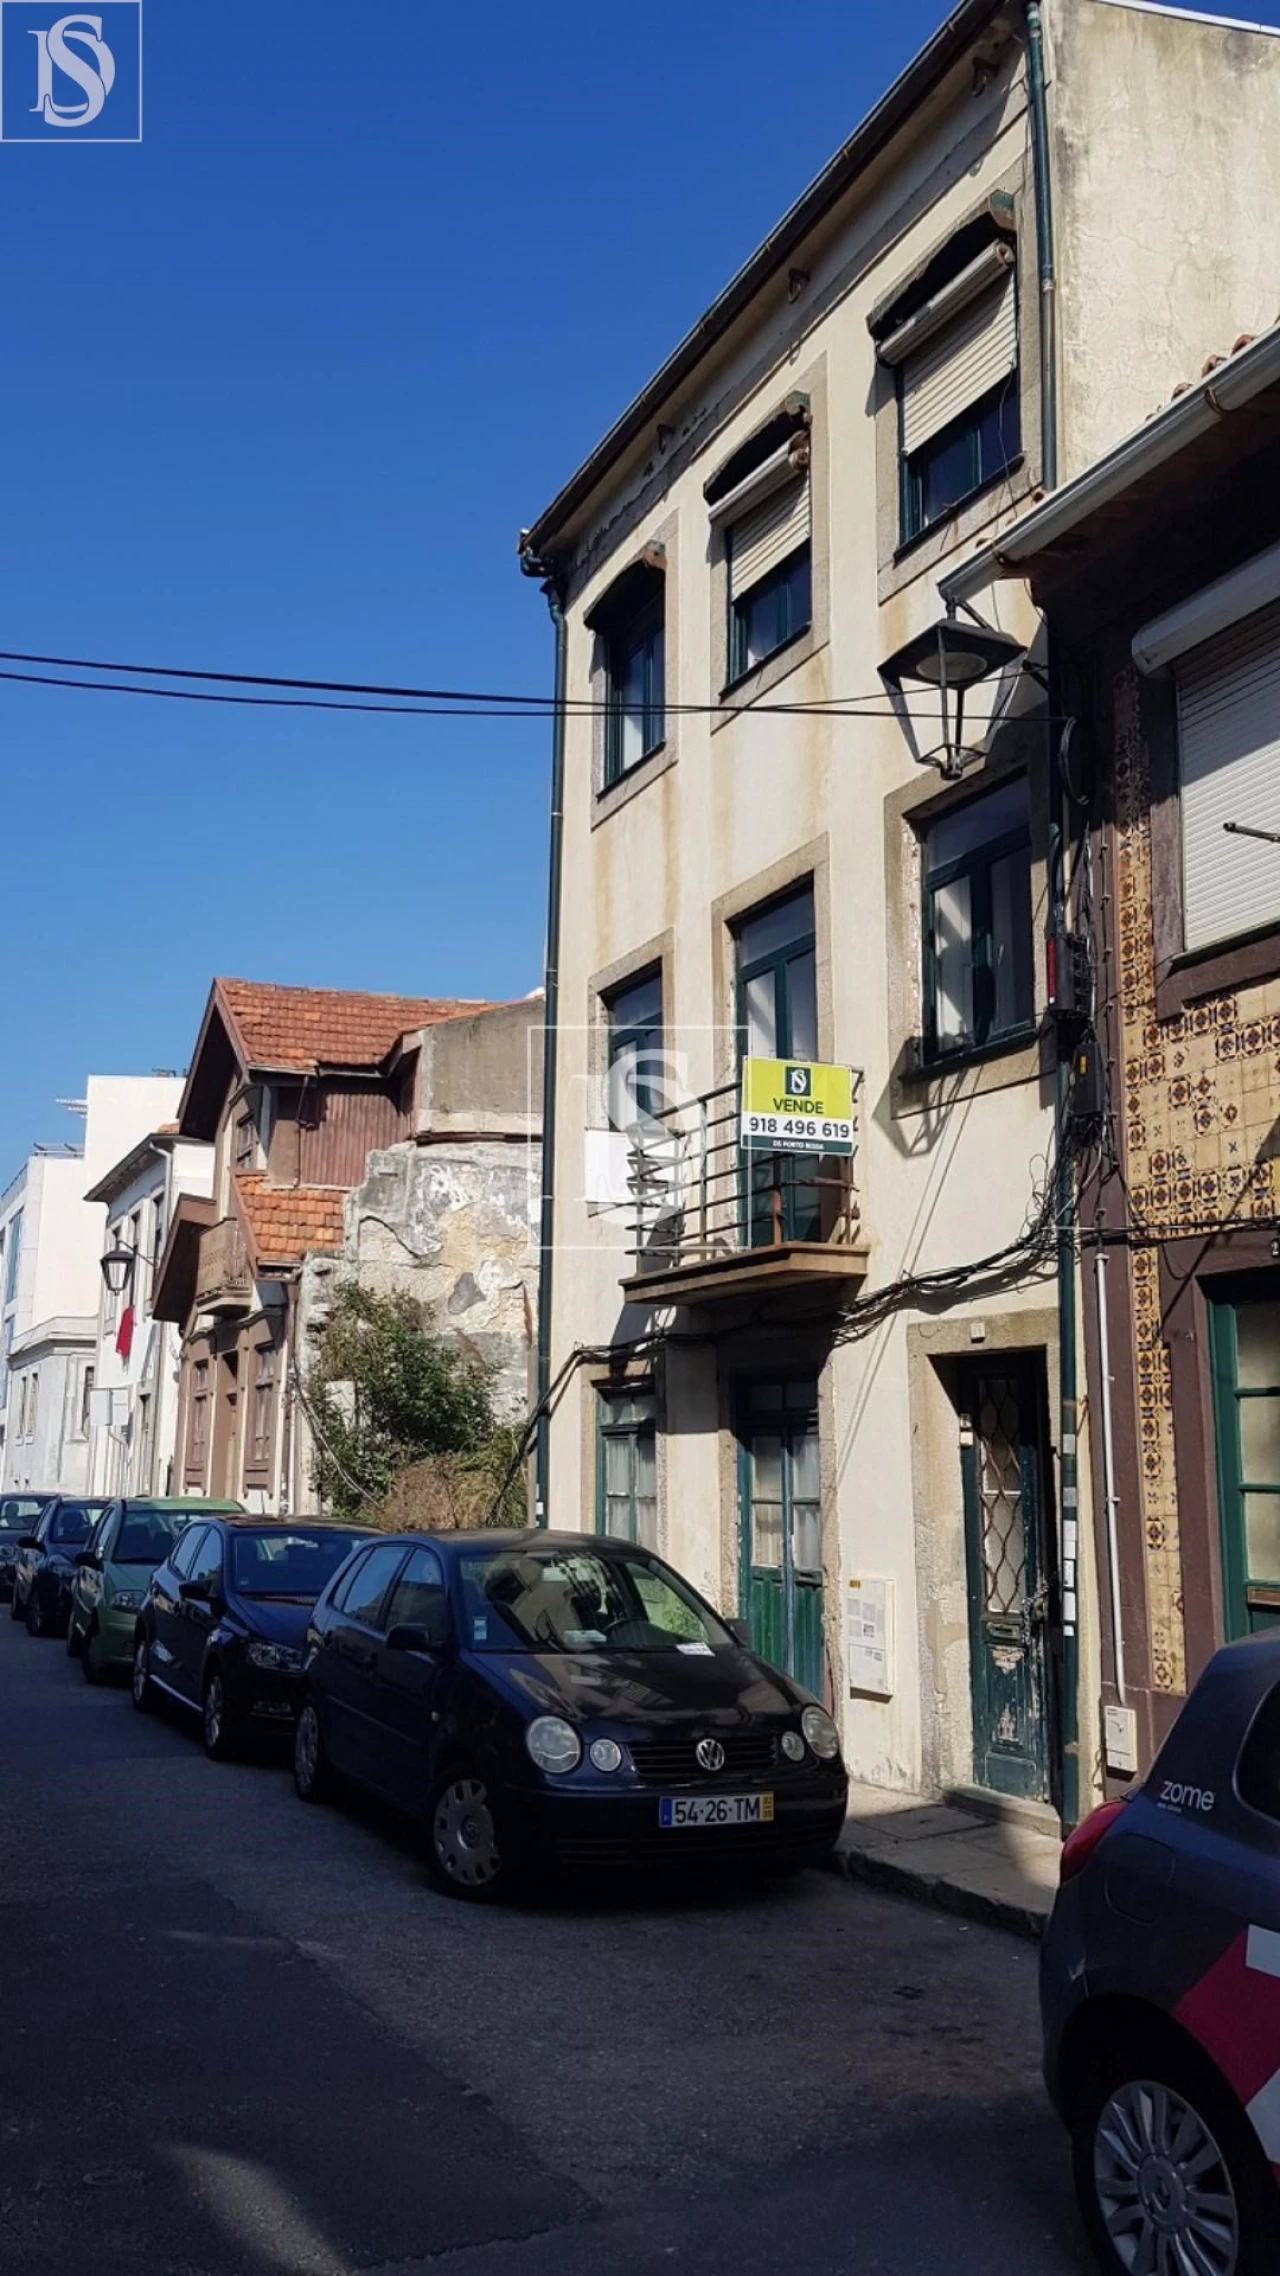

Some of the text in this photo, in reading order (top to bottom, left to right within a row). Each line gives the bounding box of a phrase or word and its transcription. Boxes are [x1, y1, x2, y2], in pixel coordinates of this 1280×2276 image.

[772, 1098, 824, 1114] VENDE
[749, 1117, 850, 1138] 918 496 619
[1160, 1780, 1215, 1811] zome
